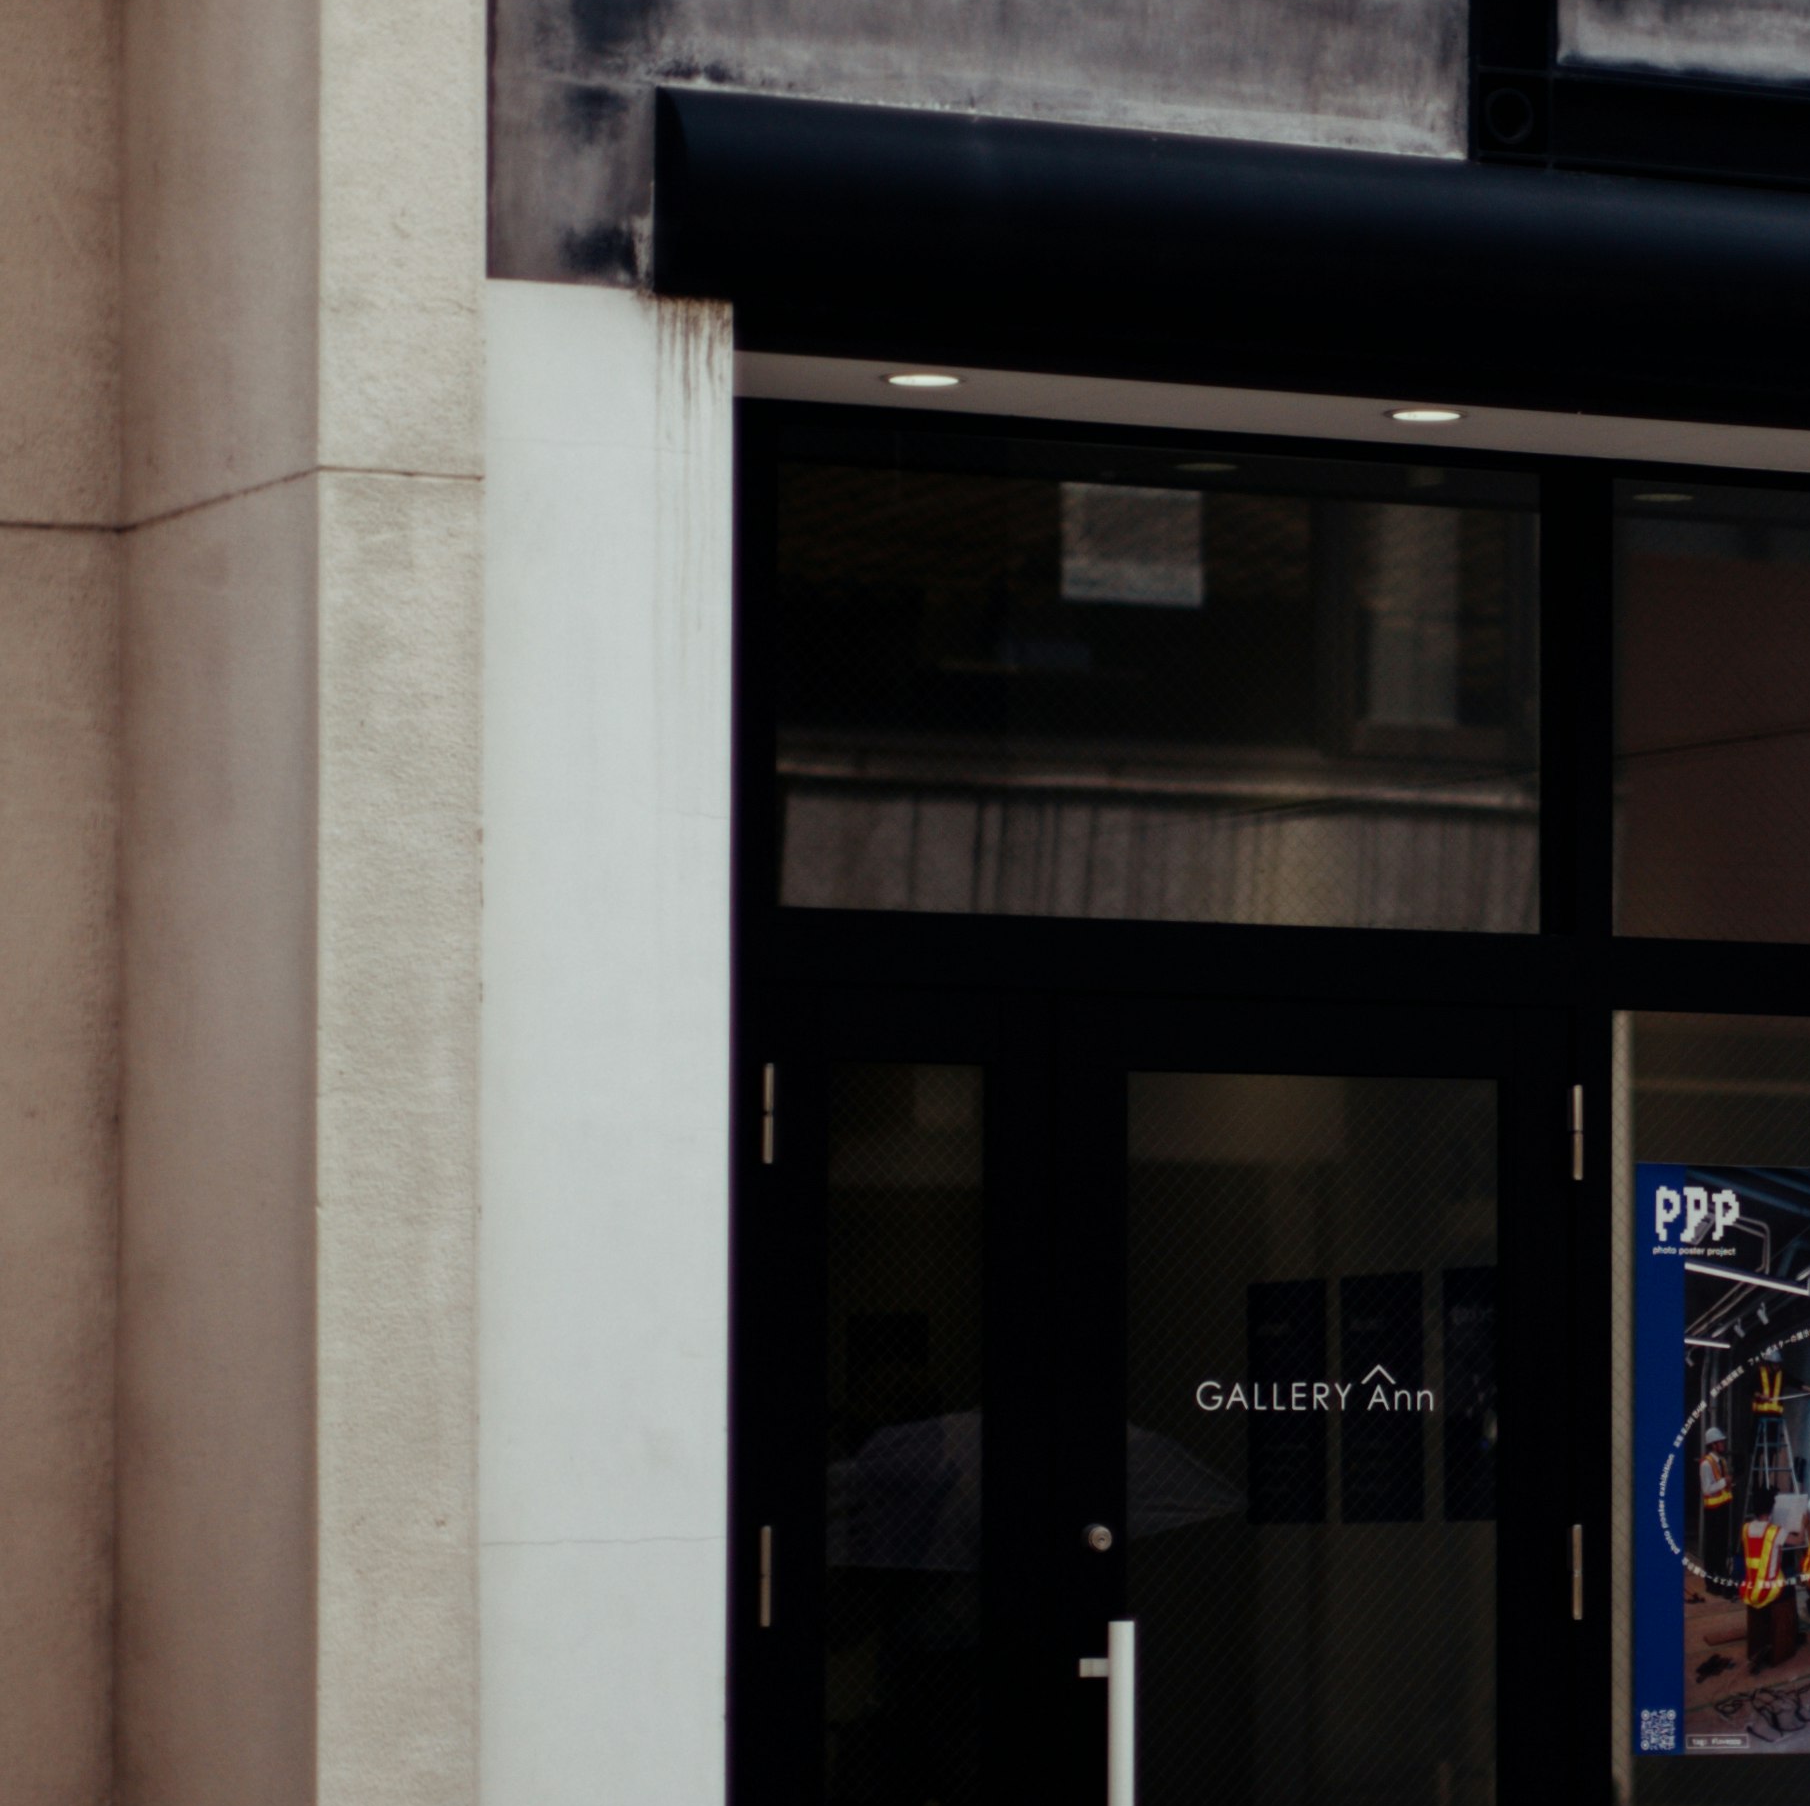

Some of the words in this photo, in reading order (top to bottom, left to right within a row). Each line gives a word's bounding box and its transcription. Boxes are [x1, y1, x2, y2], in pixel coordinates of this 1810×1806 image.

[1652, 1246, 1677, 1256] photo
[1678, 1247, 1705, 1256] poster
[1707, 1247, 1736, 1257] project
[1195, 1380, 1352, 1412] GALLERY
